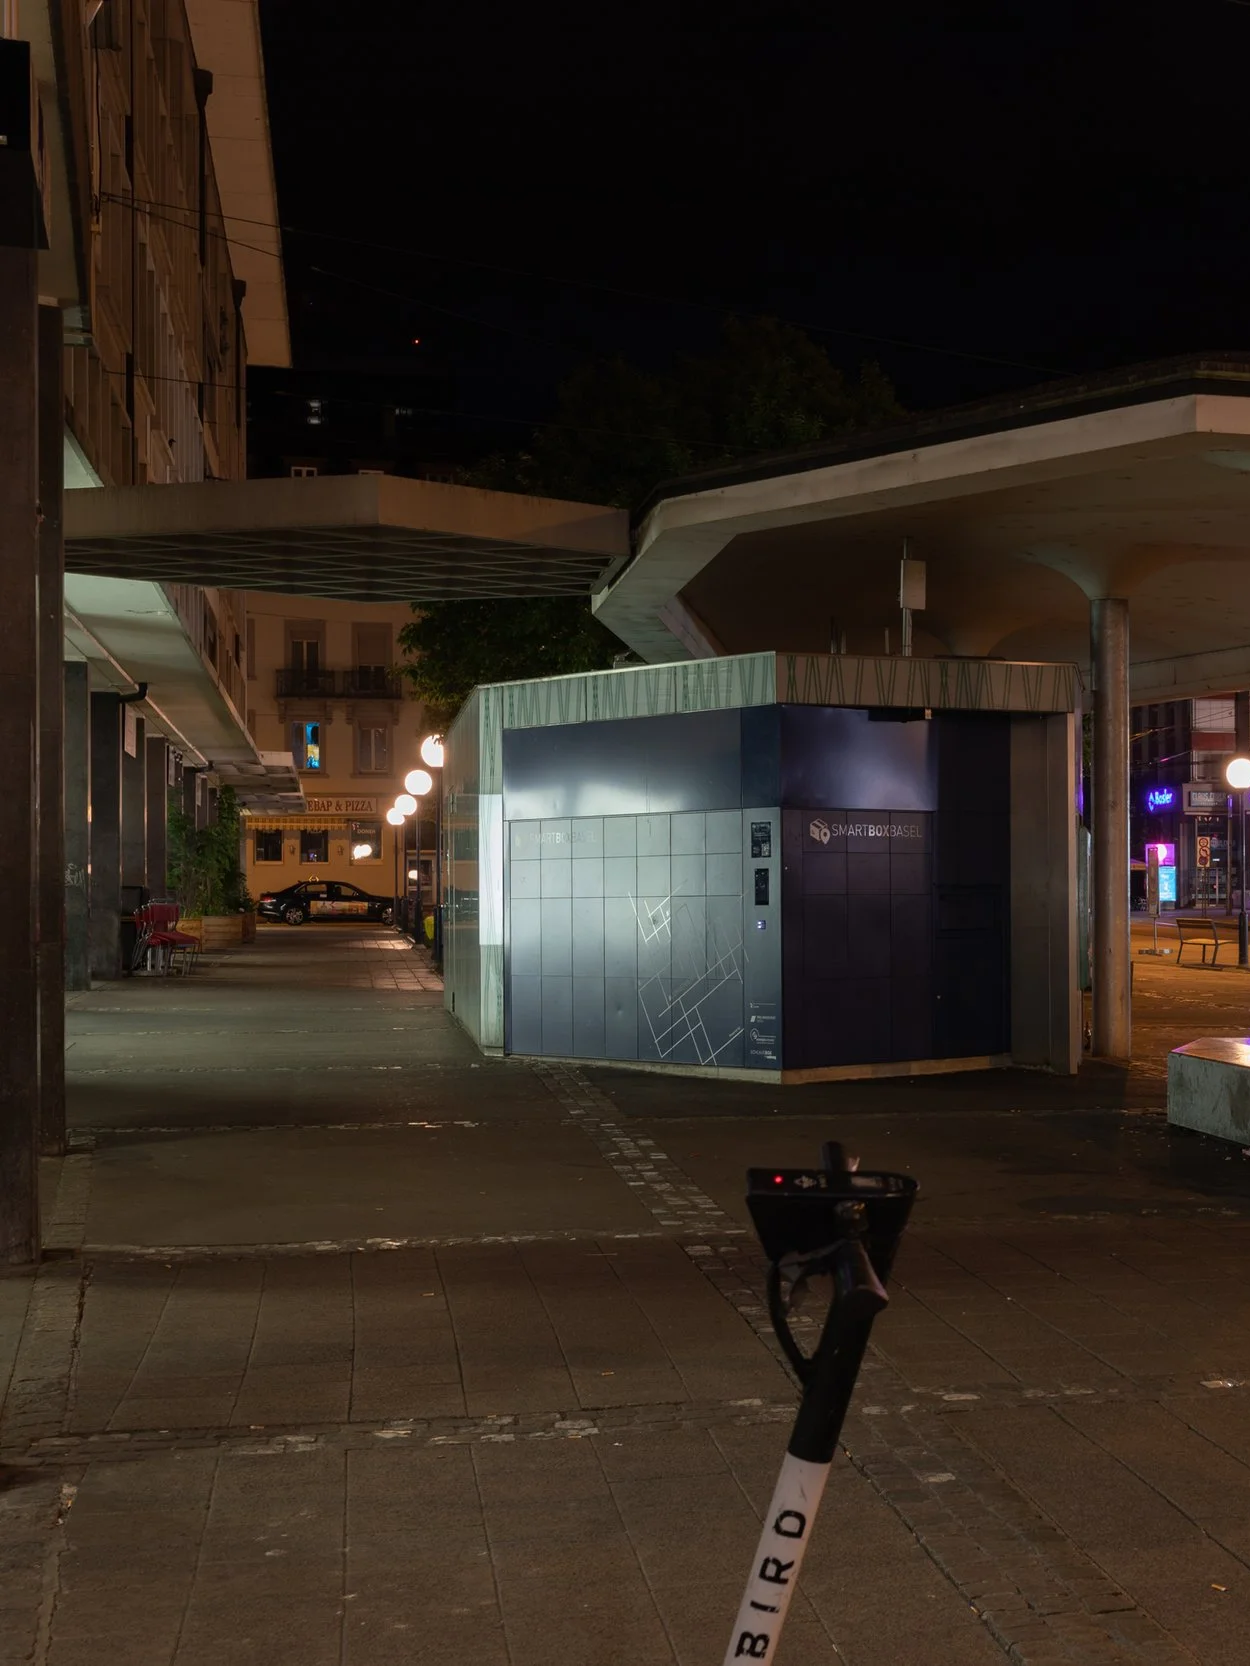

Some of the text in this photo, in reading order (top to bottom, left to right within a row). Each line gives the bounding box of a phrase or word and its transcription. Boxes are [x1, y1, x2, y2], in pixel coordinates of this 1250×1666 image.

[307, 799, 373, 812] EBAP & PIZZA
[831, 823, 923, 838] SMARTBOXBASEL
[735, 1509, 807, 1659] BIRD
